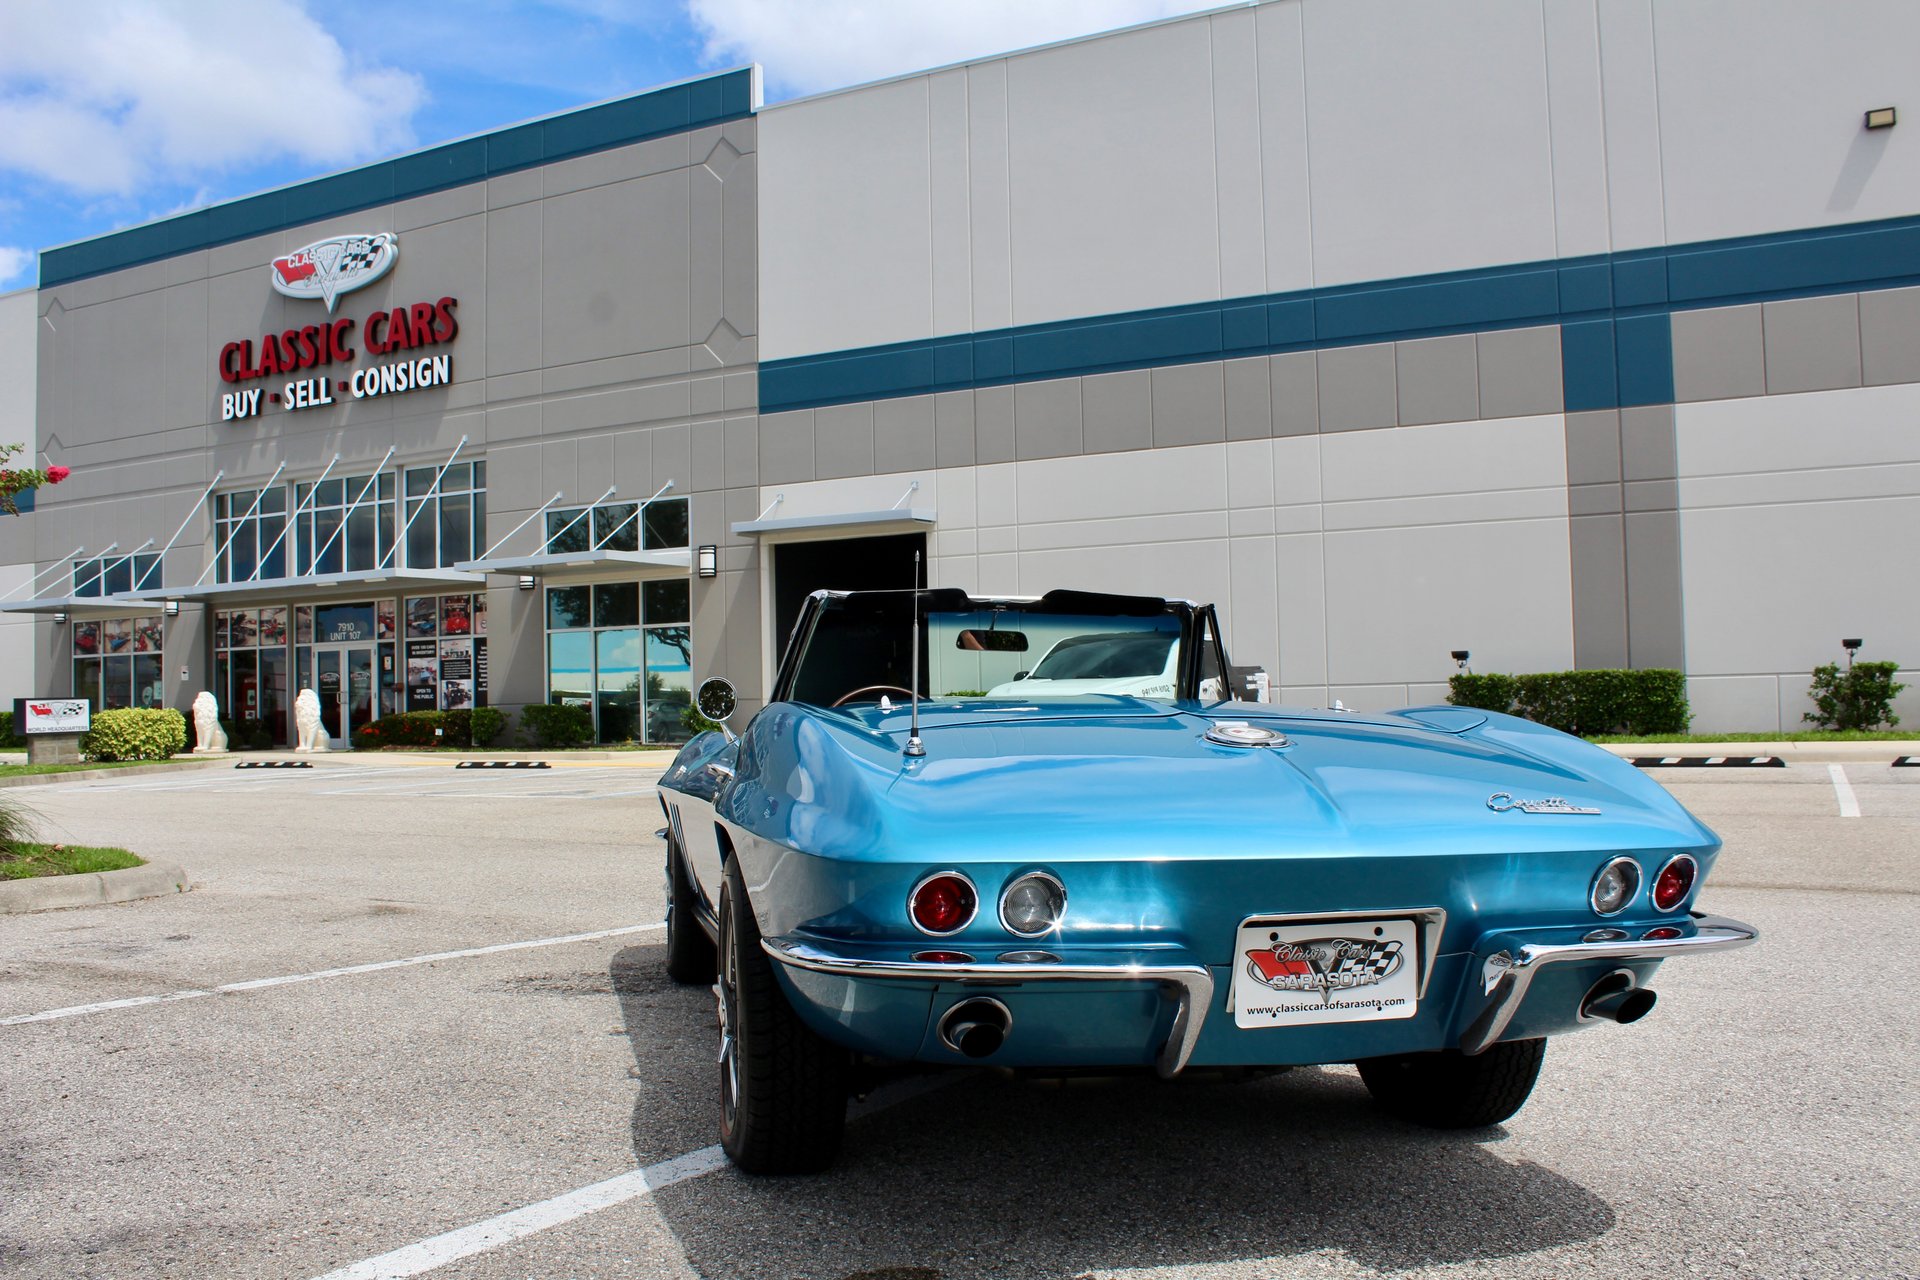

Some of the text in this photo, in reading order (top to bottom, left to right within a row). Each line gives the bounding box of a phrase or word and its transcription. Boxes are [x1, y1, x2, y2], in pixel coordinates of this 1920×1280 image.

[287, 240, 369, 268] CLASSIC CARS
[219, 296, 459, 384] CLASSIC CARS
[222, 354, 451, 420] BUY SELL CONSIGN
[330, 631, 361, 641] UNIT 107
[337, 622, 355, 631] 7910
[1270, 938, 1373, 963] Classic Cars
[1272, 968, 1379, 991] SARASOTA
[1246, 997, 1406, 1016] www.classiccarsofsarasota.com
